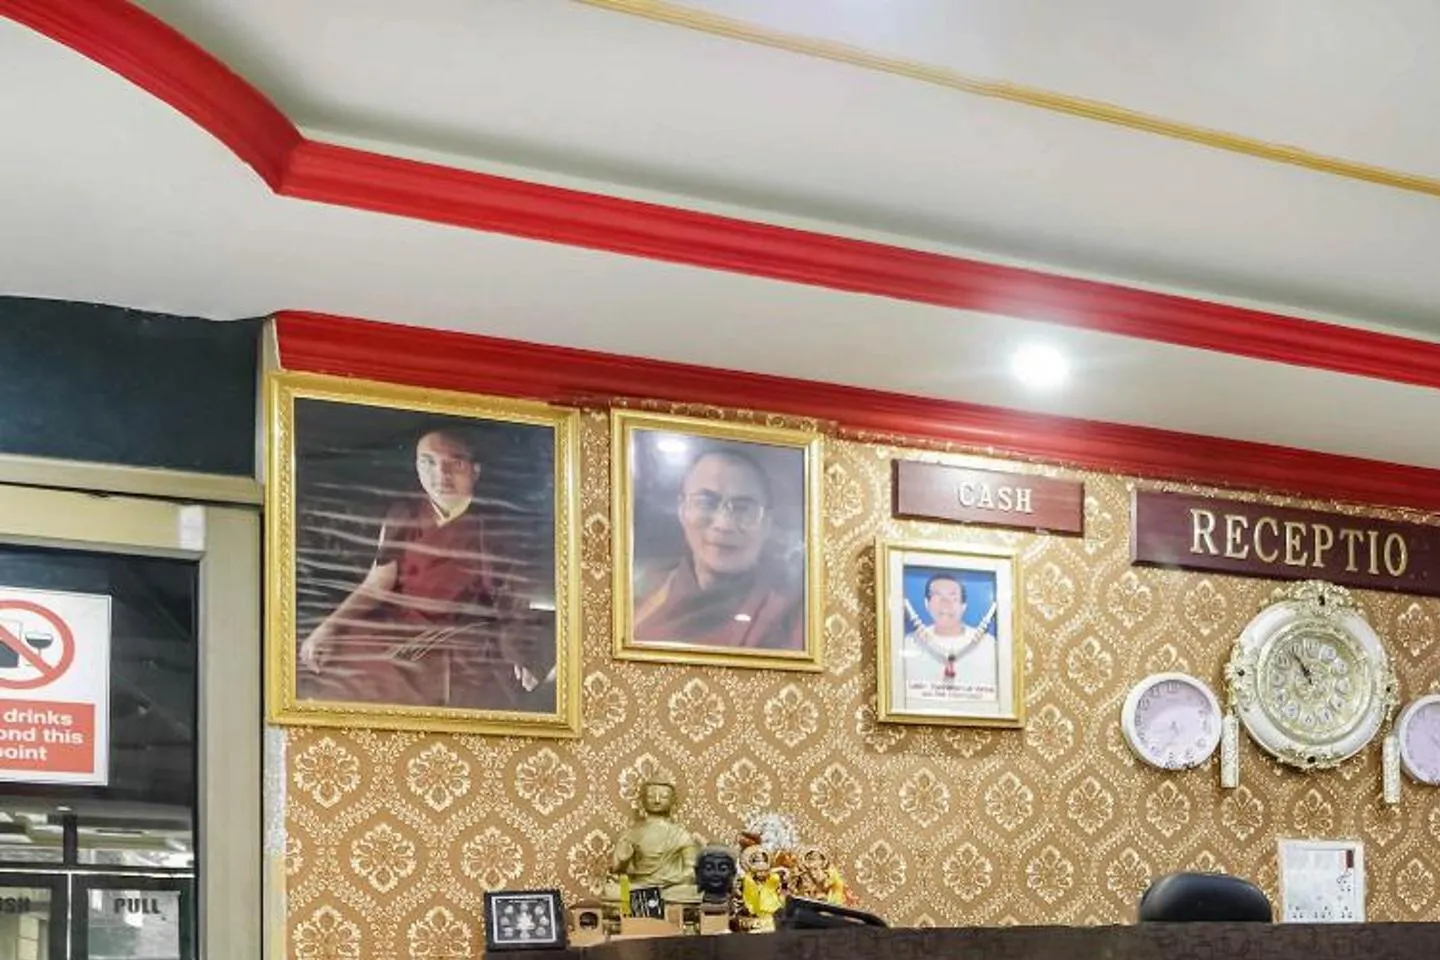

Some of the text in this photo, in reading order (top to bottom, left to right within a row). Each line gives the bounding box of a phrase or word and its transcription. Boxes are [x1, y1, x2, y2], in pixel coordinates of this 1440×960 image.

[958, 482, 1033, 514] CASH
[1189, 508, 1408, 577] RECEPTIO
[3, 708, 73, 726] drinks
[43, 728, 84, 745] this
[0, 745, 48, 762] oint
[114, 898, 161, 914] PULL
